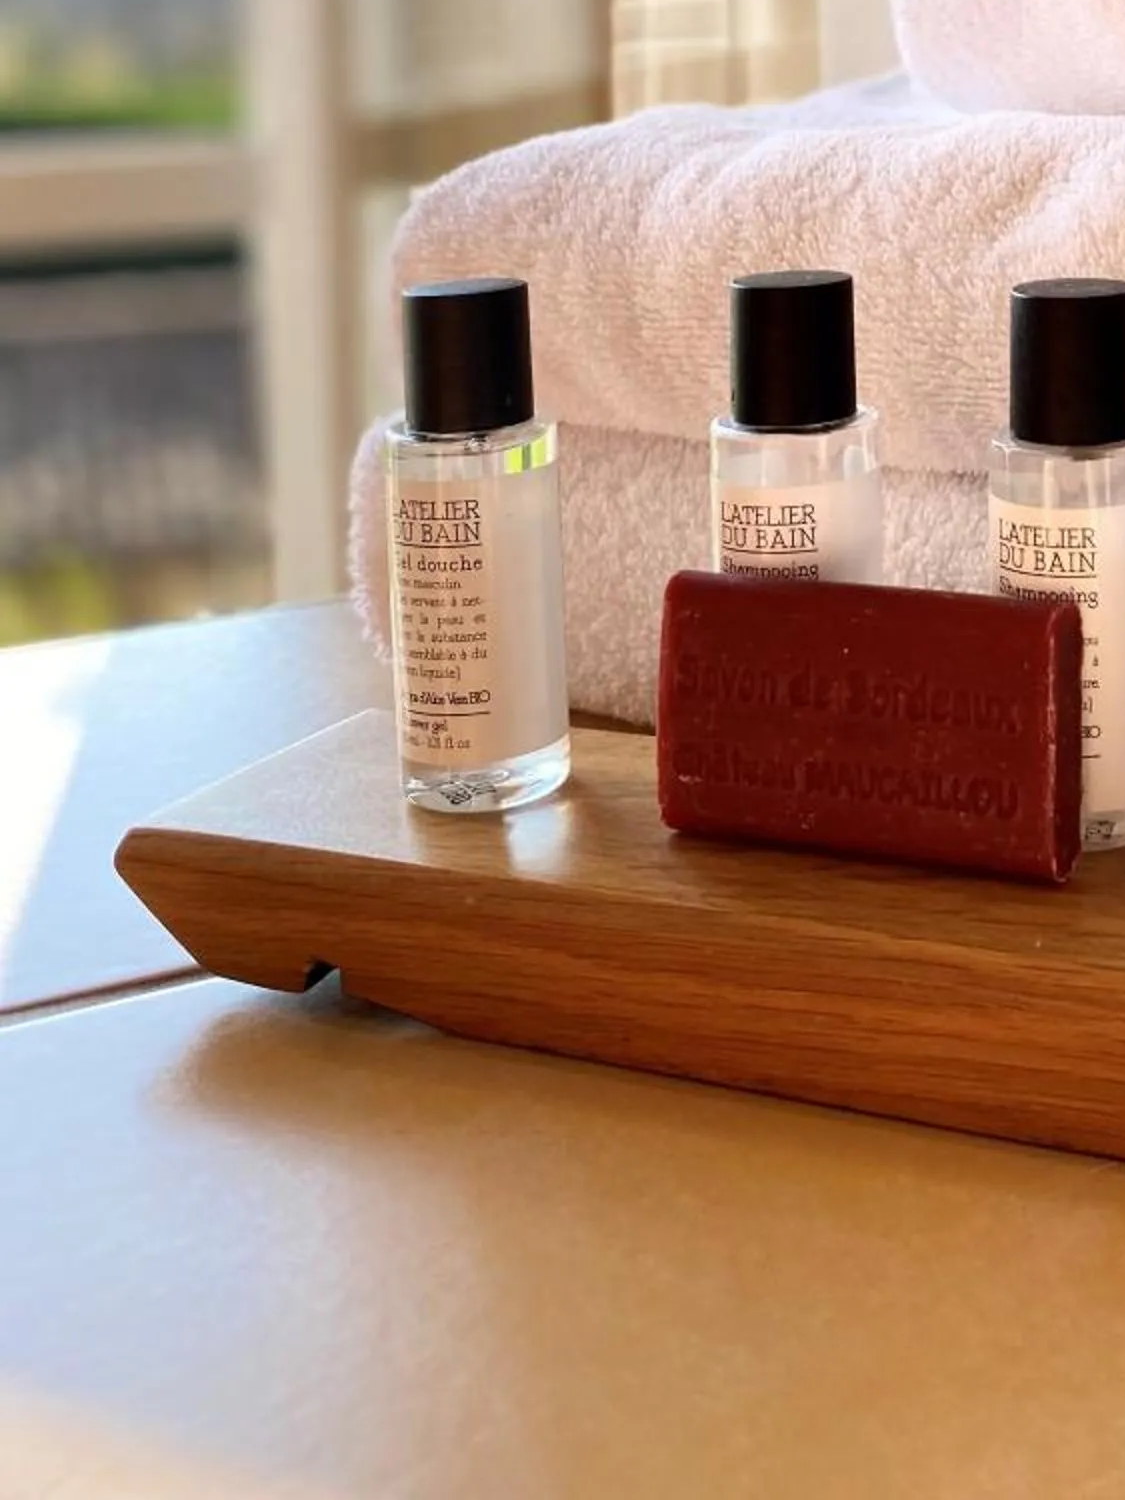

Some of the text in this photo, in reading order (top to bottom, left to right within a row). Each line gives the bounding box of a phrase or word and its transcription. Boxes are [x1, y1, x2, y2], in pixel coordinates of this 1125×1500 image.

[421, 521, 480, 543] BAIN
[722, 524, 816, 549] DU BAIN
[417, 553, 482, 572] douche
[999, 541, 1097, 573] DU BAIN
[788, 658, 834, 712] de
